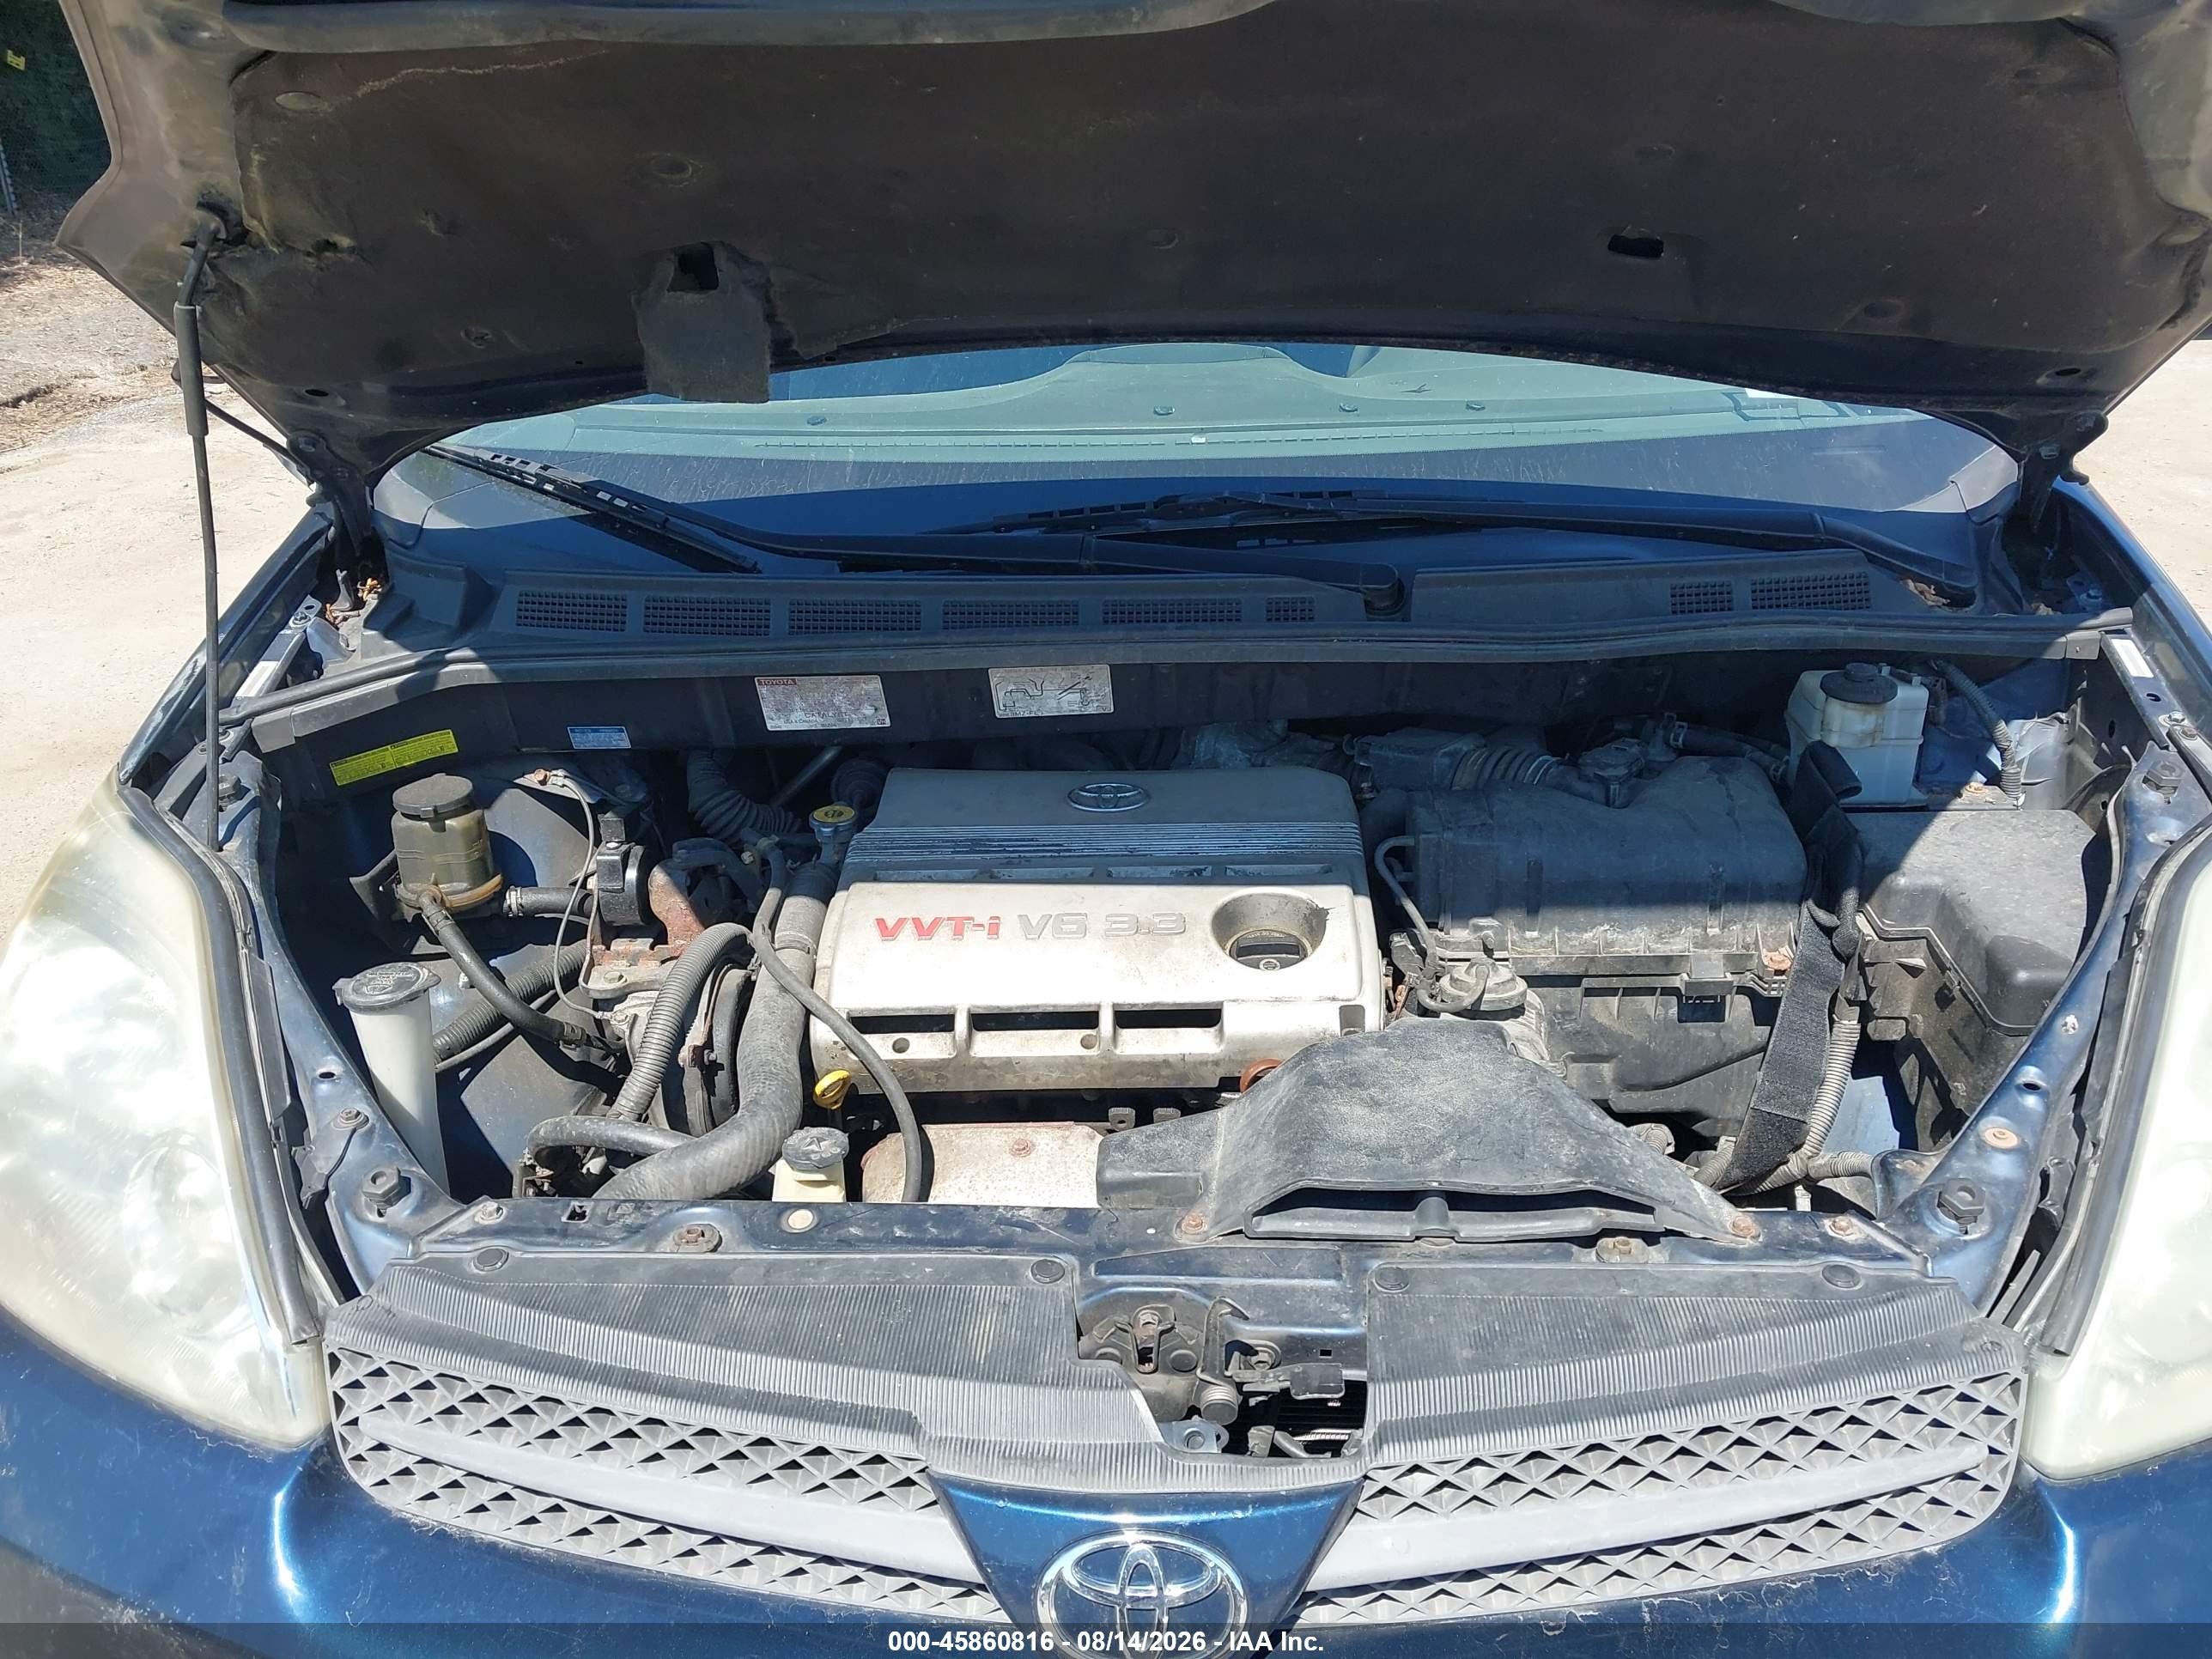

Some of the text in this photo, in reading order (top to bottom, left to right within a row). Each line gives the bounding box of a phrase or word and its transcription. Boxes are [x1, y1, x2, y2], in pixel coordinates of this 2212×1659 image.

[874, 912, 1187, 941] VVT-i V6 3.3
